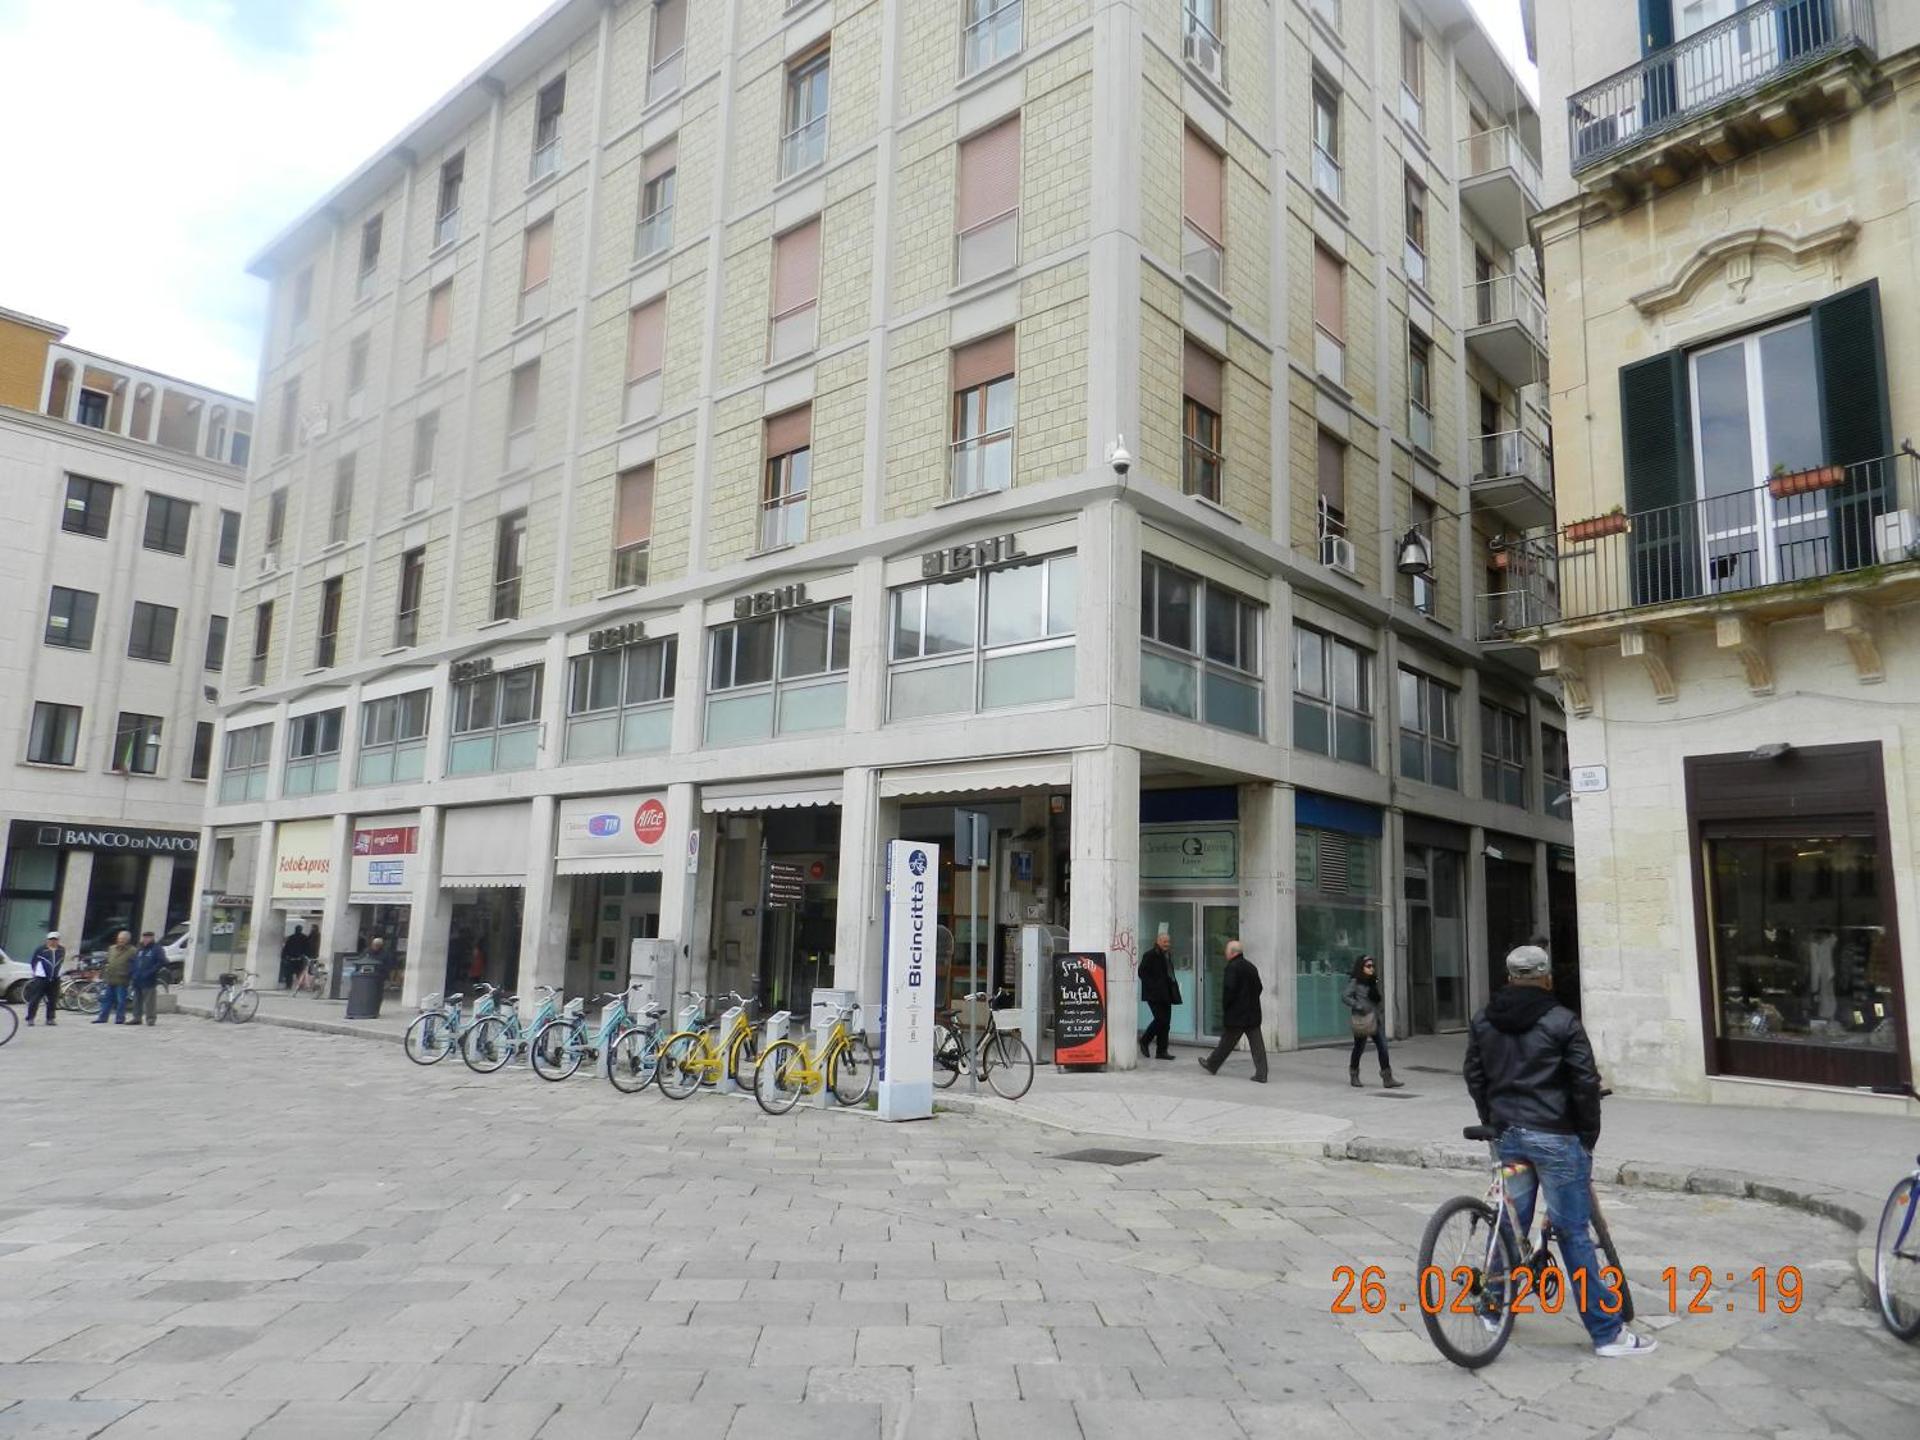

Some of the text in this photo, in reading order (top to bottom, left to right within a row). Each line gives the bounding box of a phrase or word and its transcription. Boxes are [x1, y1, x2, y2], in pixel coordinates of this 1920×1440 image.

[950, 533, 1026, 572] BNL
[753, 583, 814, 615] BNL
[65, 830, 129, 847] BANCO
[130, 839, 144, 848] DI
[908, 880, 925, 987] Bicincittà
[1075, 973, 1085, 984] la
[1060, 986, 1098, 1005] bufala
